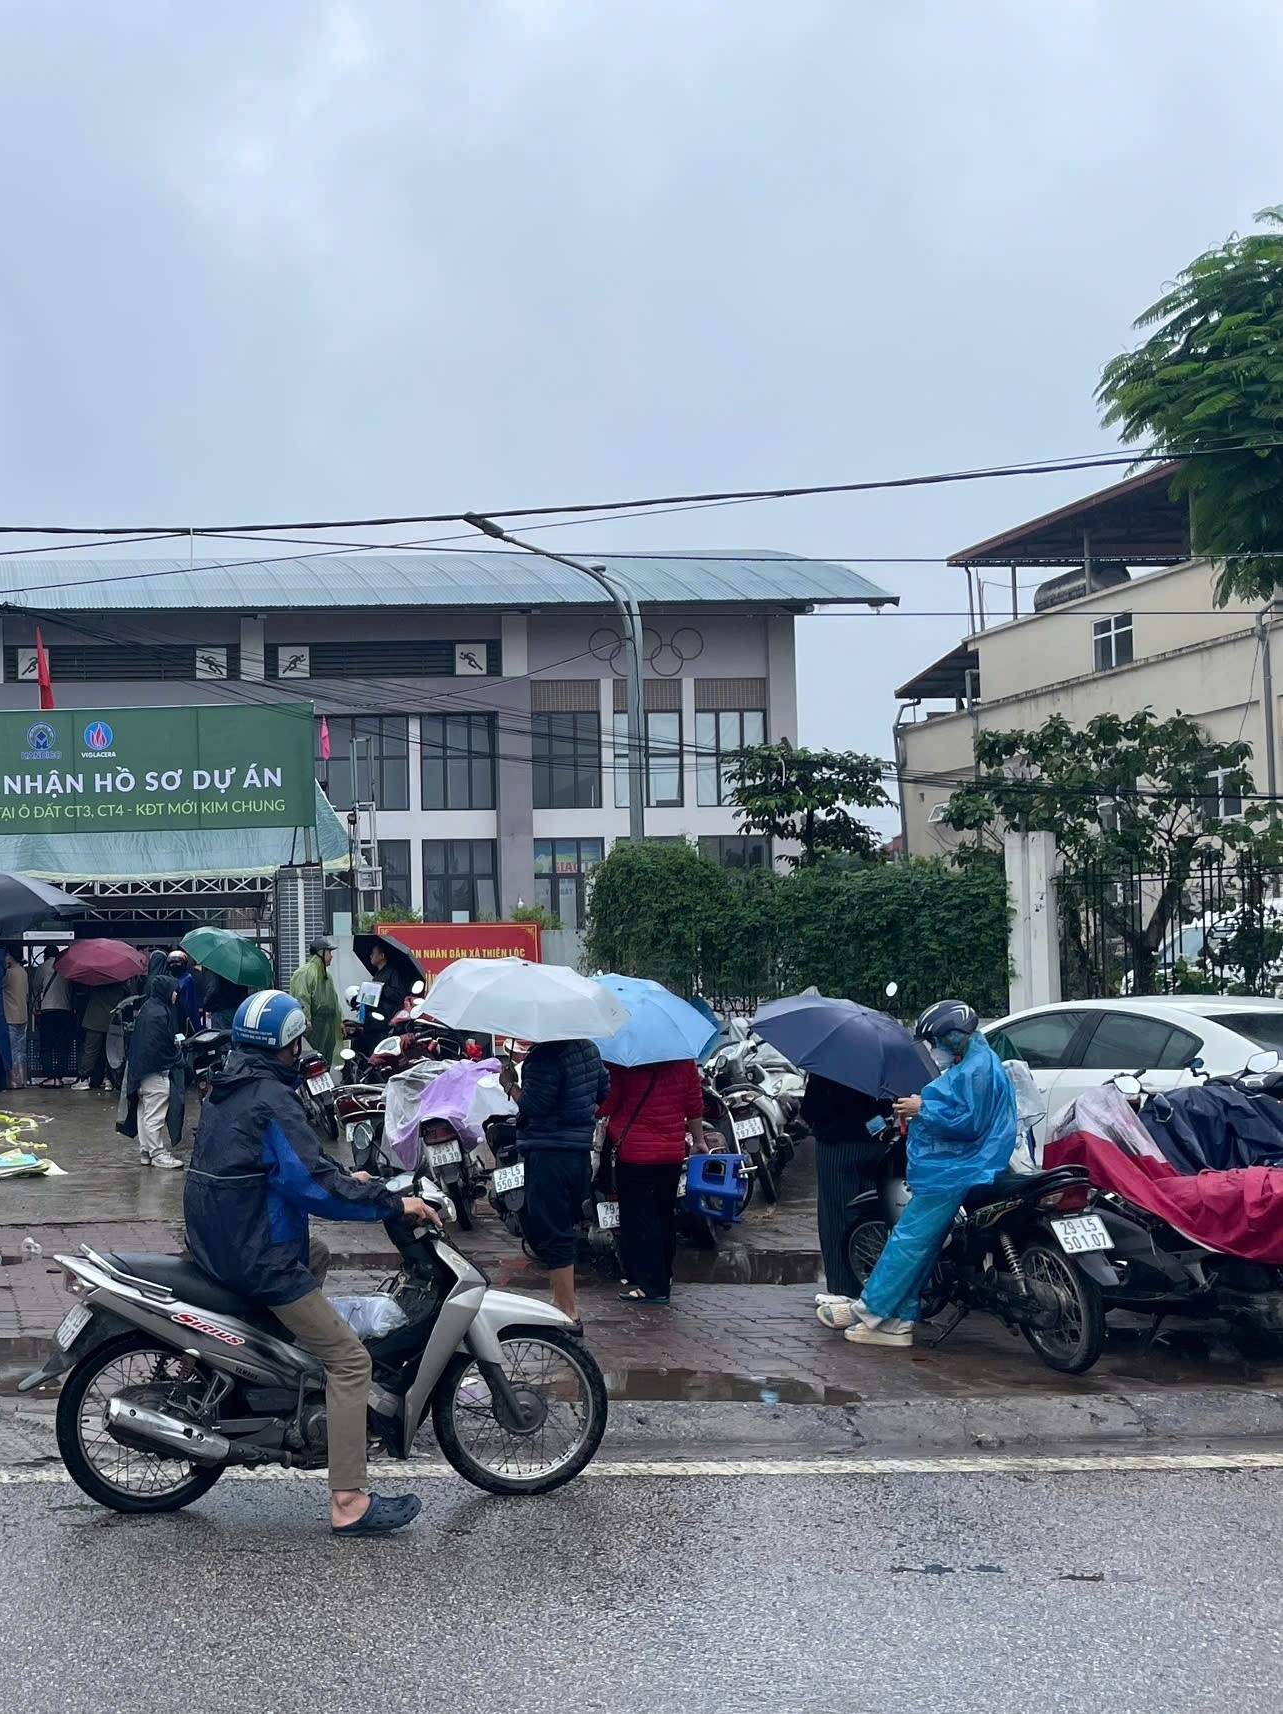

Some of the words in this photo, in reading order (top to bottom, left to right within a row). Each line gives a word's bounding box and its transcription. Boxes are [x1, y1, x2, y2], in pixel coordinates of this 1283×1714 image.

[4, 769, 84, 799] NHẬN
[94, 766, 136, 793] HỒ
[145, 768, 183, 792] SƠ
[192, 767, 237, 794] DỰ
[242, 763, 282, 788] ÁN
[18, 803, 30, 818] Ô
[33, 802, 62, 818] ĐẤT
[64, 804, 94, 819] CT3,
[97, 804, 124, 817] CT4
[136, 803, 165, 816] KĐT
[168, 799, 197, 815] MỚI
[201, 801, 228, 814] KIM
[232, 799, 286, 812] CHUNG
[423, 947, 447, 959] NHÂN
[449, 947, 467, 959] DÂN
[469, 947, 480, 958] XÃ
[482, 947, 508, 958] THIÊN
[498, 1166, 521, 1180] 29-L5
[497, 1175, 524, 1191] 550.92
[1059, 1219, 1098, 1236] 29-L5
[1063, 1233, 1108, 1251] 501.07
